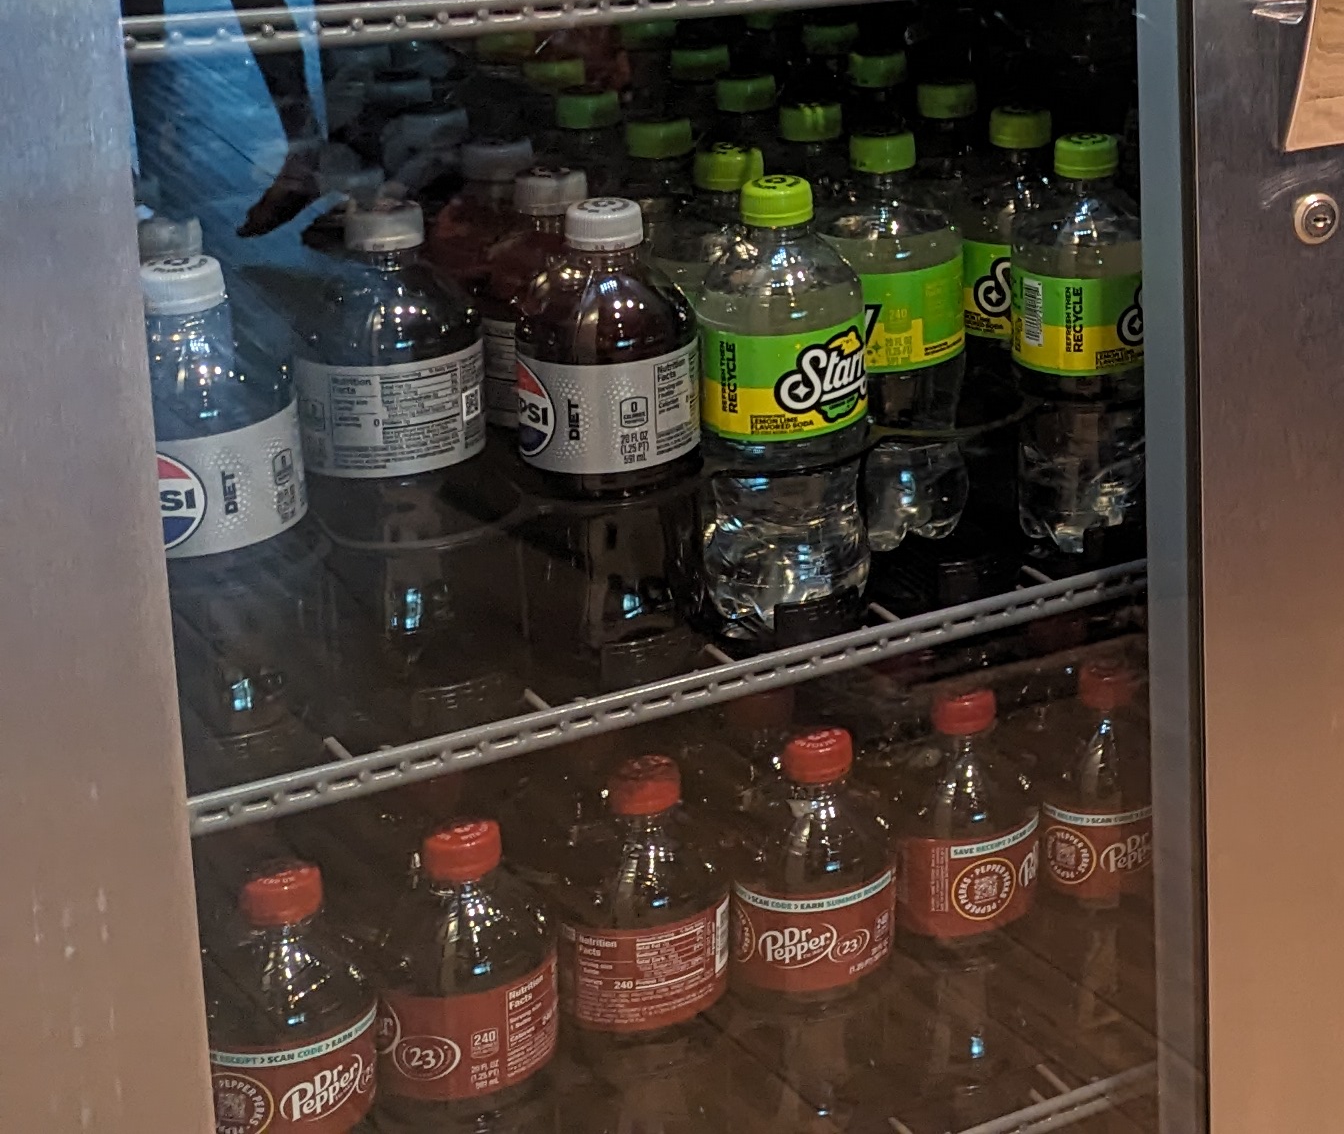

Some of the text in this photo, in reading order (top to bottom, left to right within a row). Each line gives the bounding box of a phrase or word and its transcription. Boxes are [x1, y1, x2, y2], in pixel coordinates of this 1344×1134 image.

[1072, 286, 1084, 353] RECYCLE
[725, 342, 739, 414] RECYCLE
[631, 401, 638, 413] 0
[567, 399, 580, 441] DIET
[631, 432, 638, 443] FL
[221, 471, 239, 516] DIET
[1127, 832, 1149, 850] Dr
[953, 847, 974, 856] SAVE
[800, 902, 824, 910] EARN
[784, 927, 812, 946] Dr
[758, 930, 832, 964] Pepper
[842, 939, 858, 955] 23
[508, 975, 545, 1001] Nutrition
[614, 981, 634, 990] 240
[508, 993, 533, 1011] Facts
[473, 1030, 496, 1047] 240
[267, 1053, 295, 1064] SCAN
[298, 1046, 323, 1059] CODE
[409, 1047, 437, 1070] 23
[314, 1065, 343, 1091] Dr
[280, 1062, 359, 1123] Pepper
